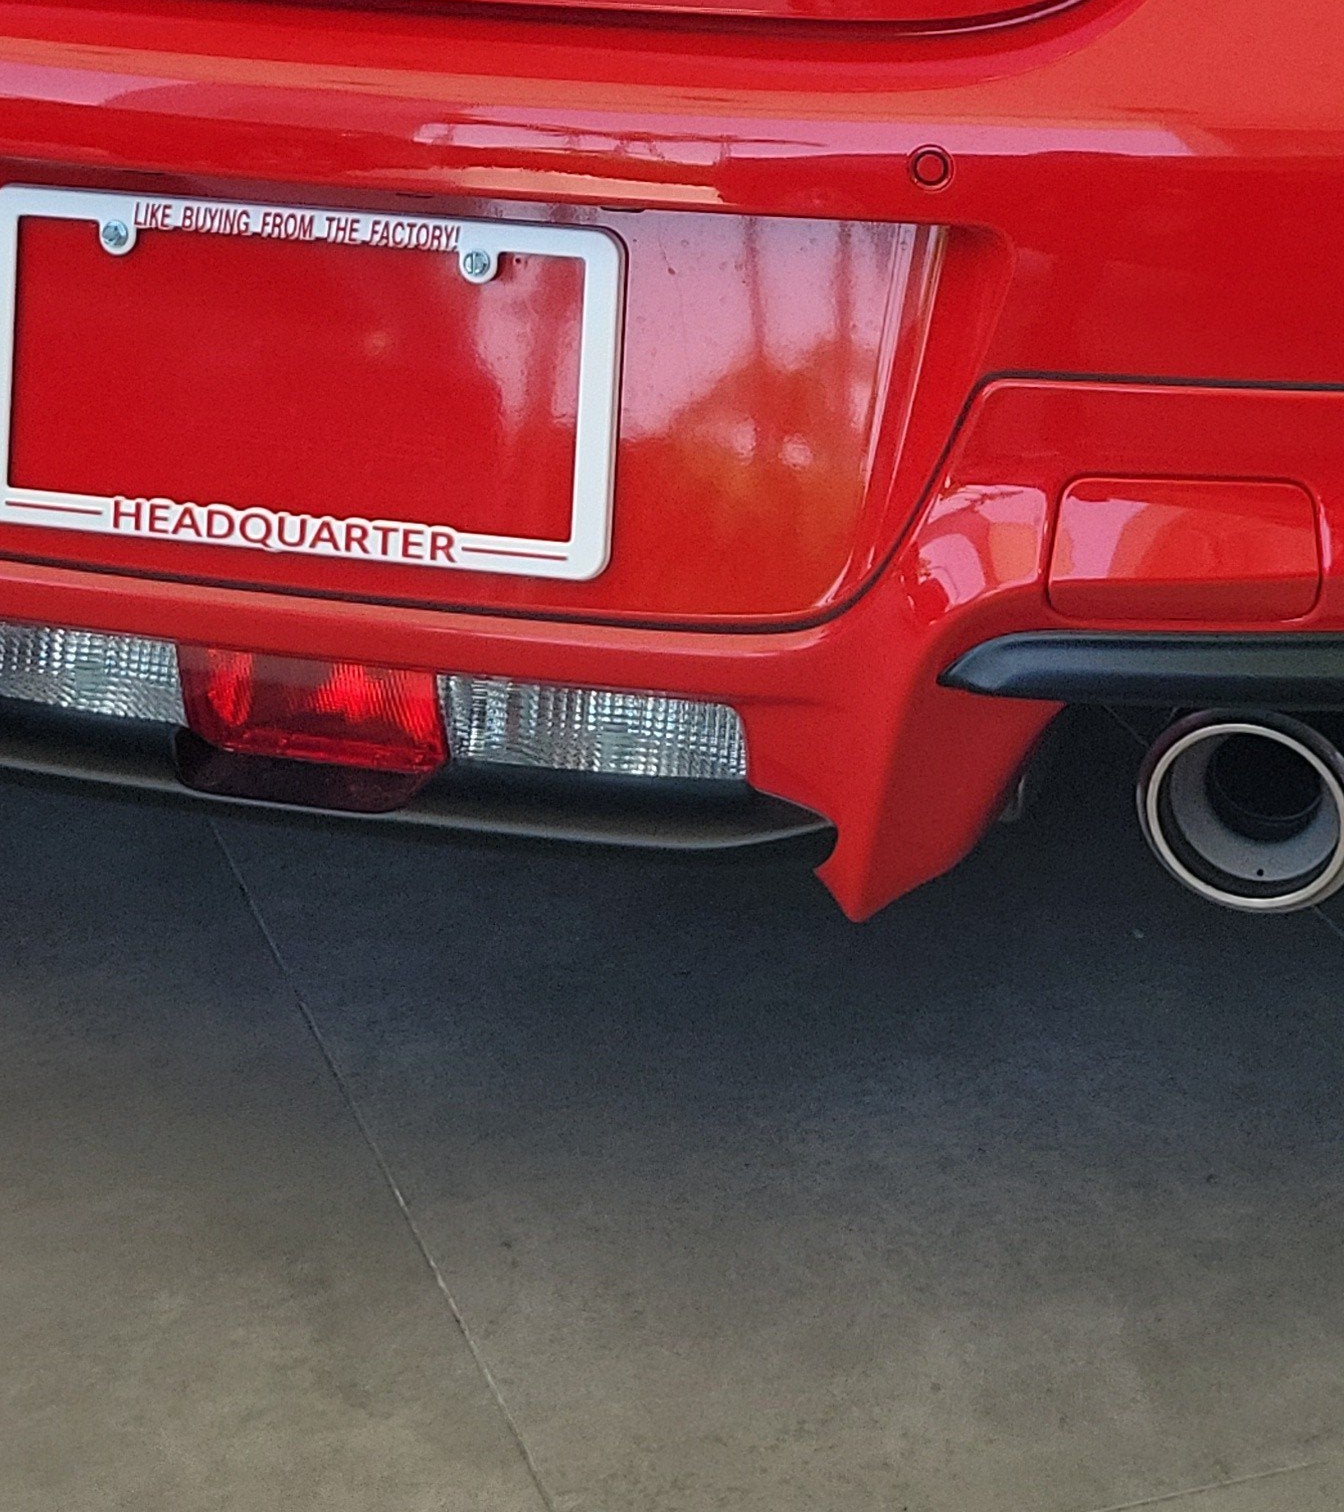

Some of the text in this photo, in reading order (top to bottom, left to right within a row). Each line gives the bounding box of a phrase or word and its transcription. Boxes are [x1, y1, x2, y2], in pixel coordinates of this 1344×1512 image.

[133, 201, 461, 252] LIKE BUYING FROM THE FACTORY!
[111, 498, 457, 563] HEADQUARTER
